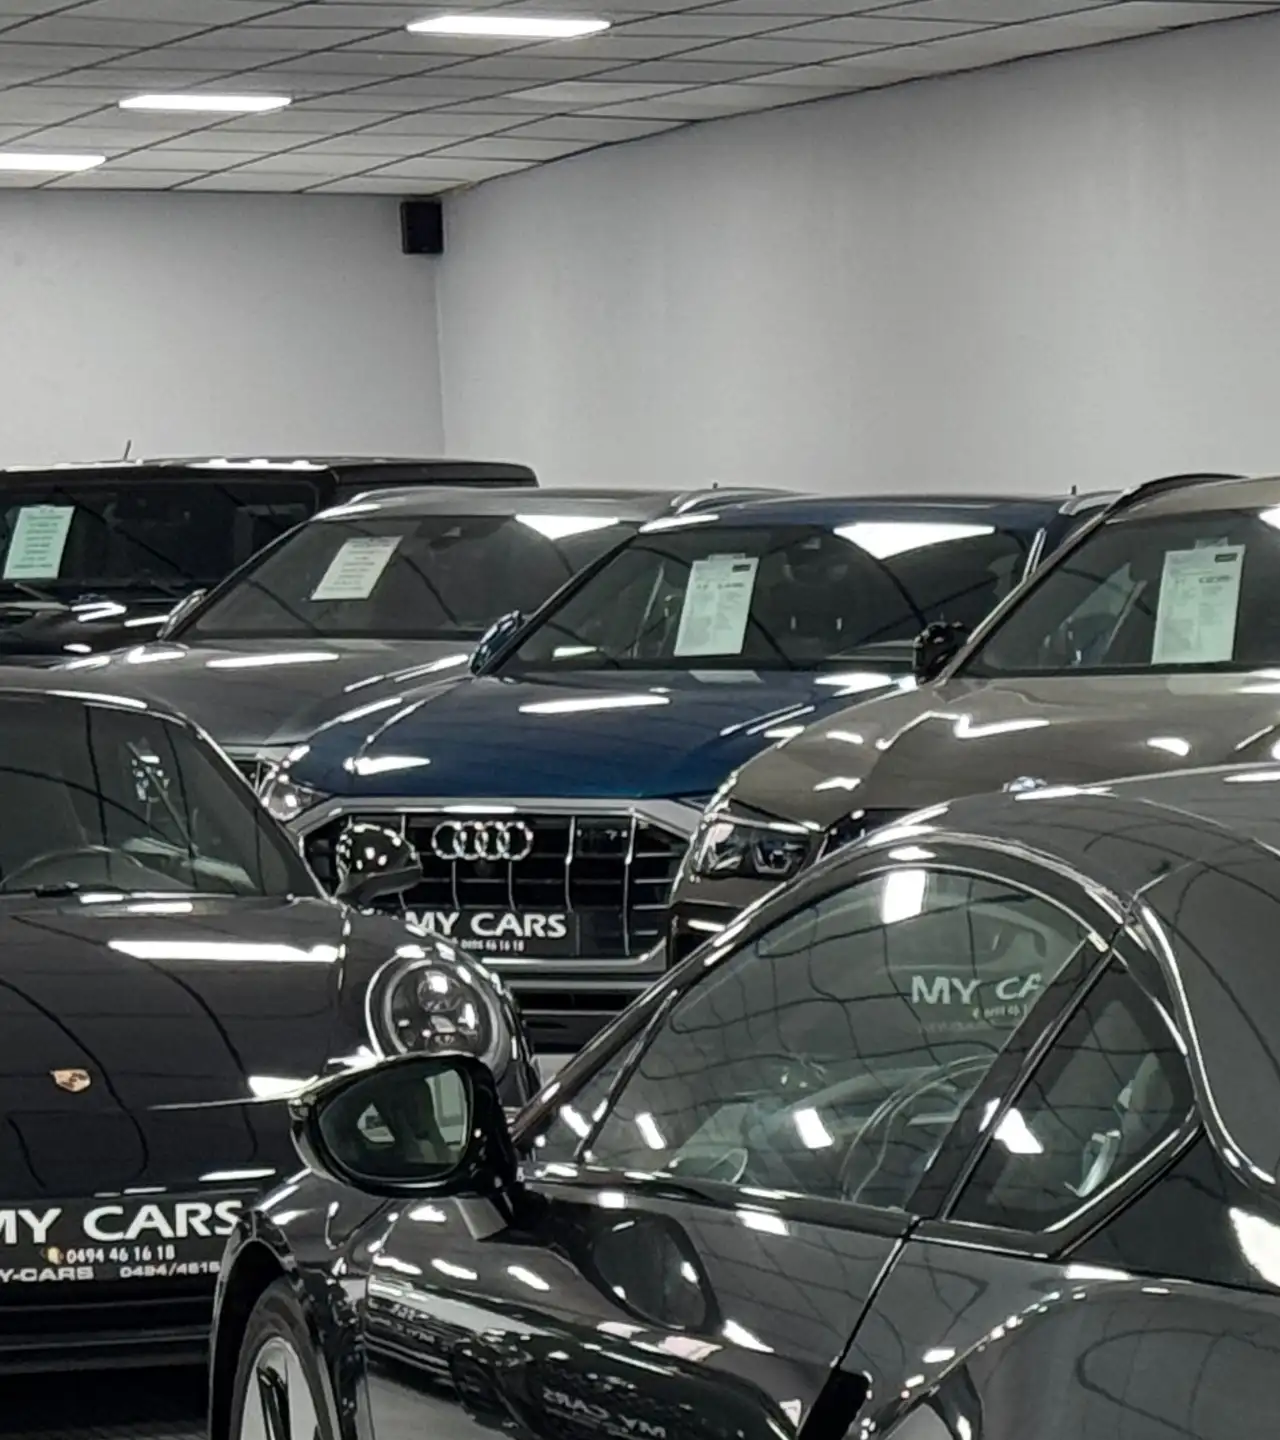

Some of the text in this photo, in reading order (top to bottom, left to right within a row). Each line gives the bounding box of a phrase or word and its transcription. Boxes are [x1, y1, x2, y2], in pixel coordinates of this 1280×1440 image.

[405, 911, 567, 938] MY CARS
[911, 975, 982, 1005] MY
[83, 1200, 244, 1241] CARS
[66, 1244, 176, 1265] 0494 46 16 18
